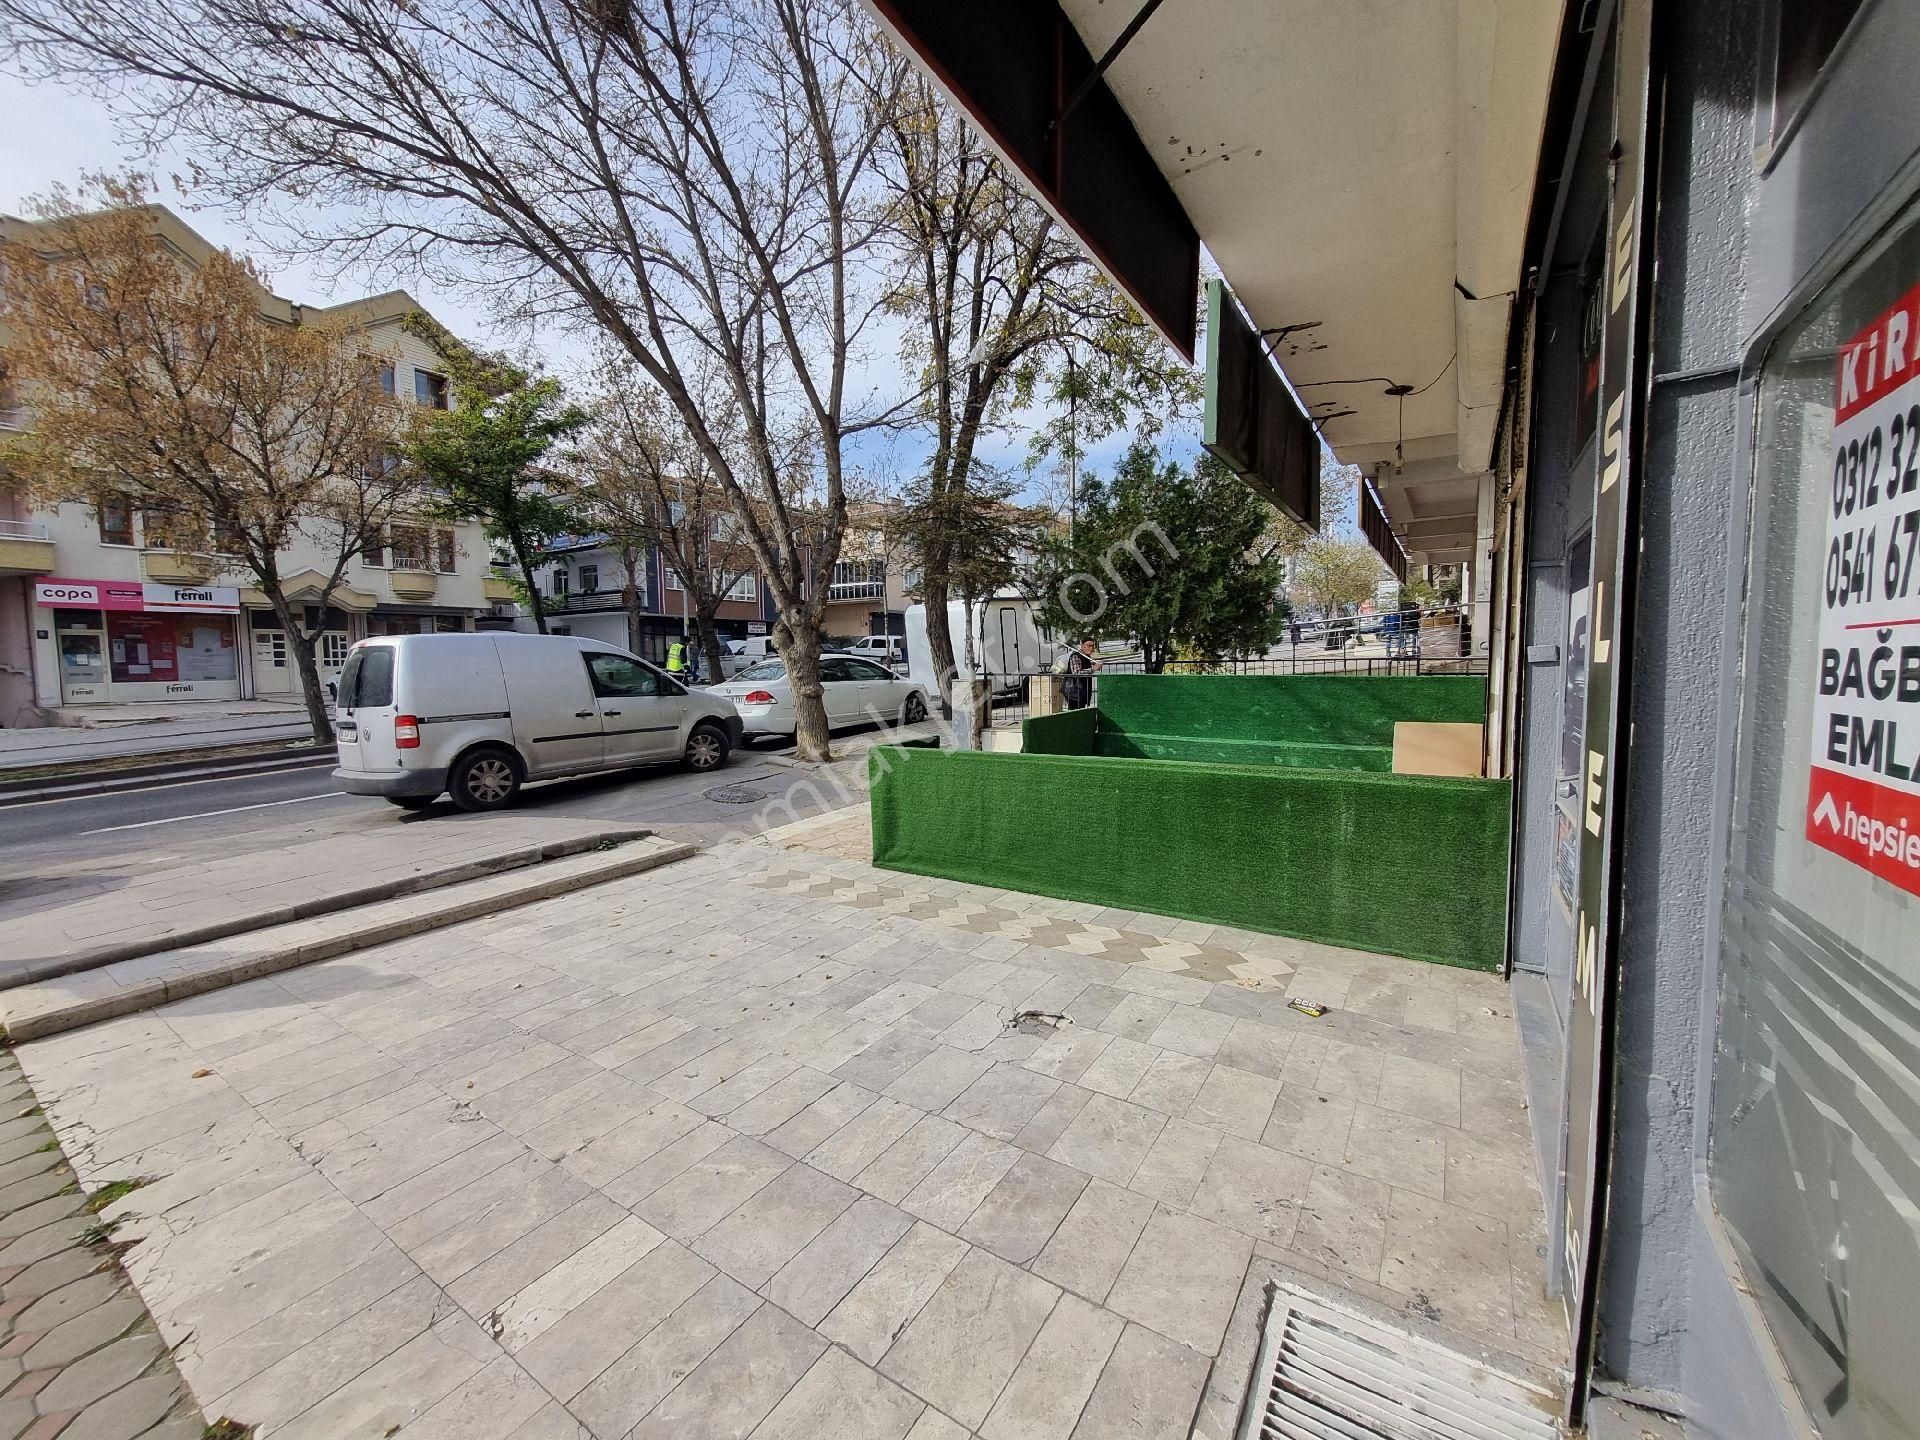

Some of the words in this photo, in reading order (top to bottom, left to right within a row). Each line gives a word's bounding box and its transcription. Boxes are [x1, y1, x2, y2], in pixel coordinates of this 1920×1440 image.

[1840, 309, 1920, 410] KiR
[1833, 426, 1882, 520] 0312
[43, 588, 93, 601] copa
[174, 587, 213, 602] Ferroli
[1826, 524, 1877, 609] 0541
[1819, 628, 1920, 703] BAĞB
